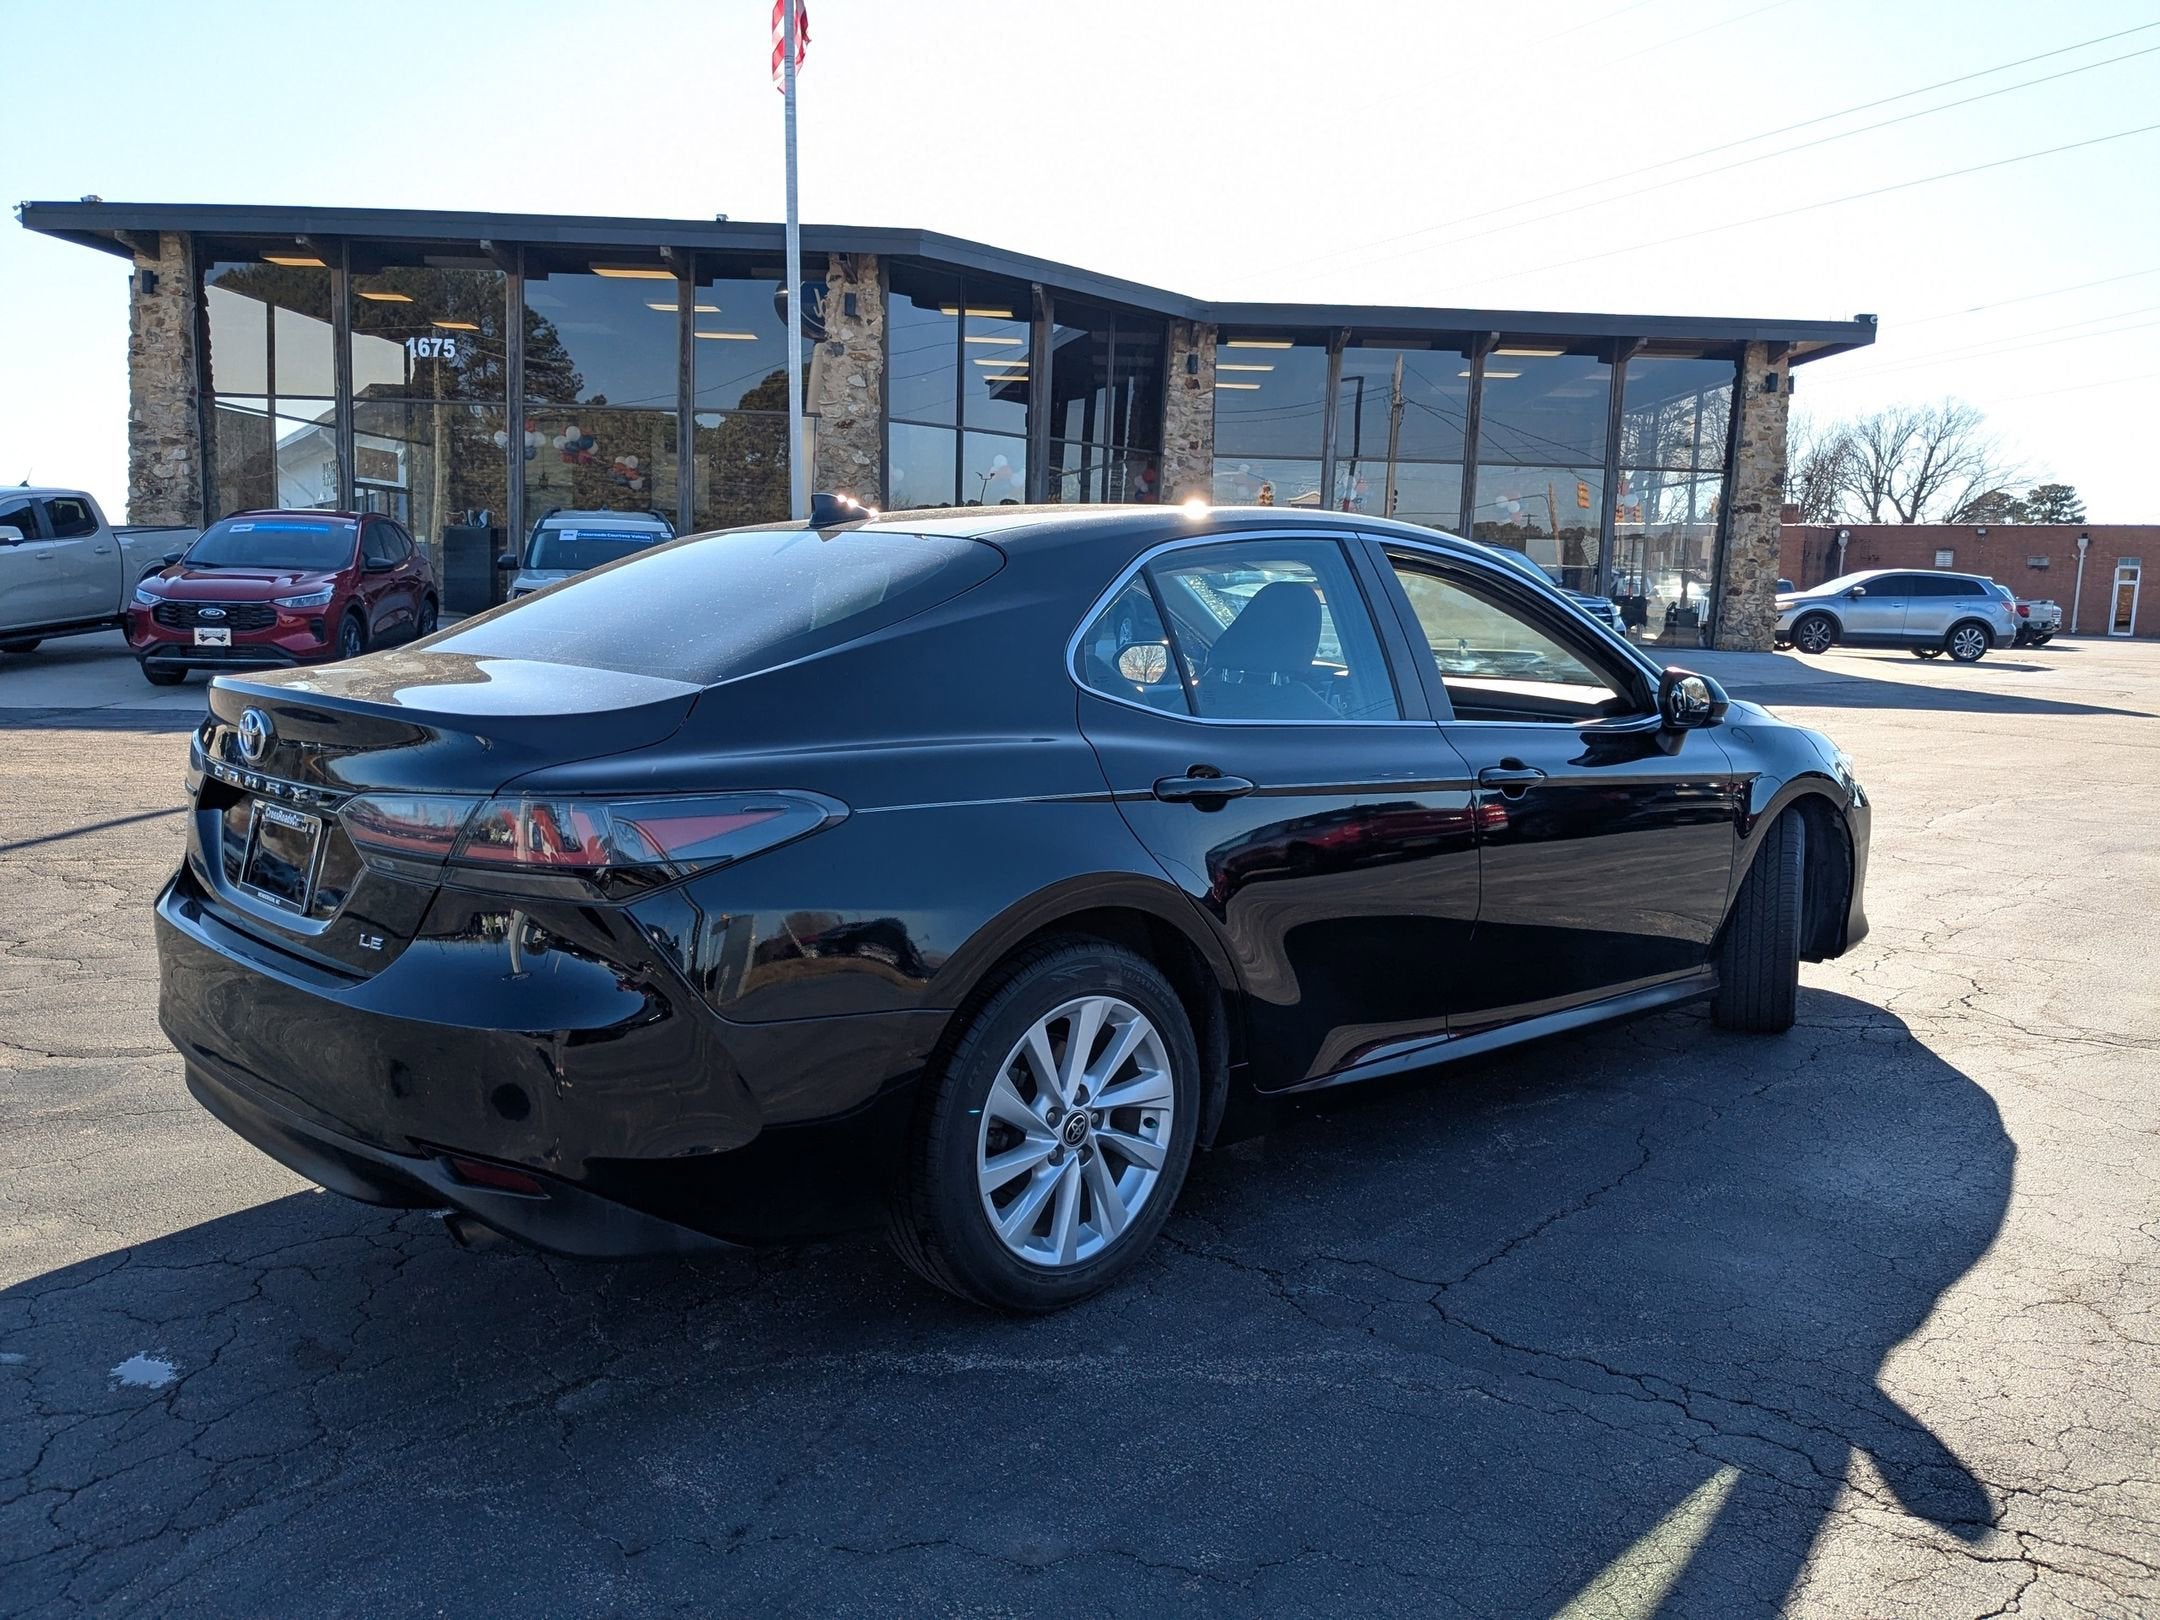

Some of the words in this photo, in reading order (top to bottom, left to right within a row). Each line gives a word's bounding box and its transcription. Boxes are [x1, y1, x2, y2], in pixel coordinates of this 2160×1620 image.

[405, 337, 456, 358] 1675
[214, 764, 308, 802] CAMRY
[359, 933, 384, 950] LE
